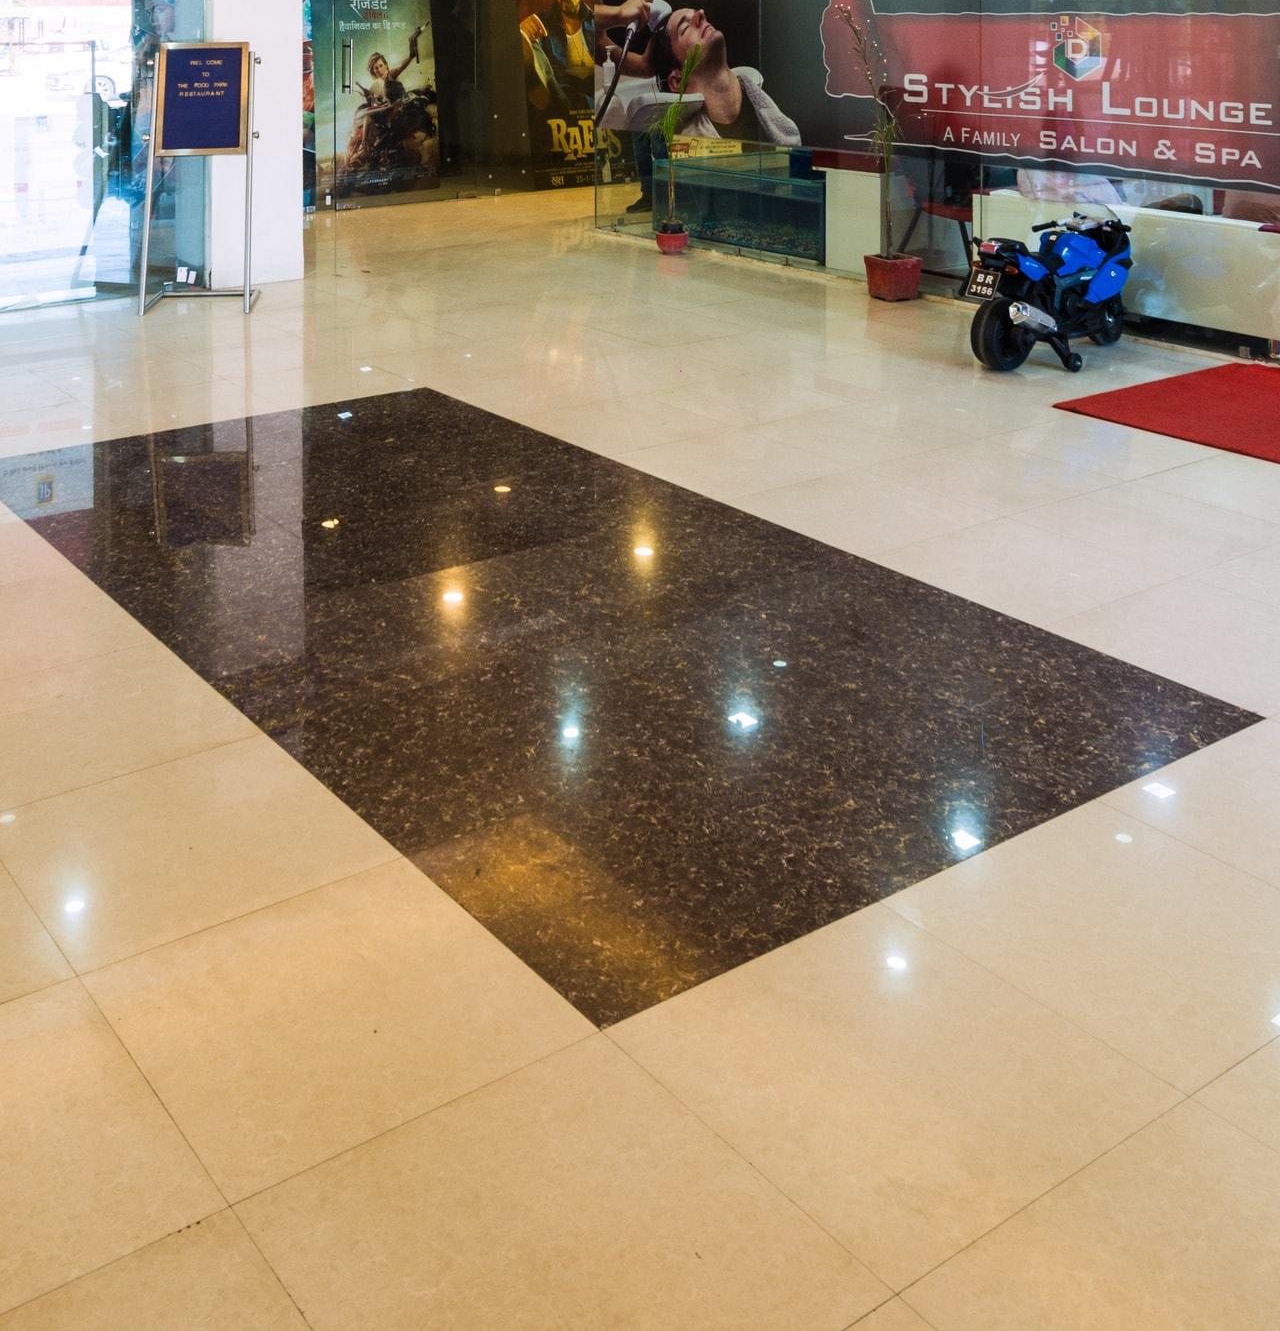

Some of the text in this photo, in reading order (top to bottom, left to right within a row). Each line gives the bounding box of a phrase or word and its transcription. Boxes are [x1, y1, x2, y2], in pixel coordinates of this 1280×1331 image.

[903, 73, 1273, 125] STYLISH LOUNGE
[547, 118, 622, 160] RAEES
[943, 127, 1262, 169] A FAMILY SALON & SPA
[970, 284, 993, 296] 3156
